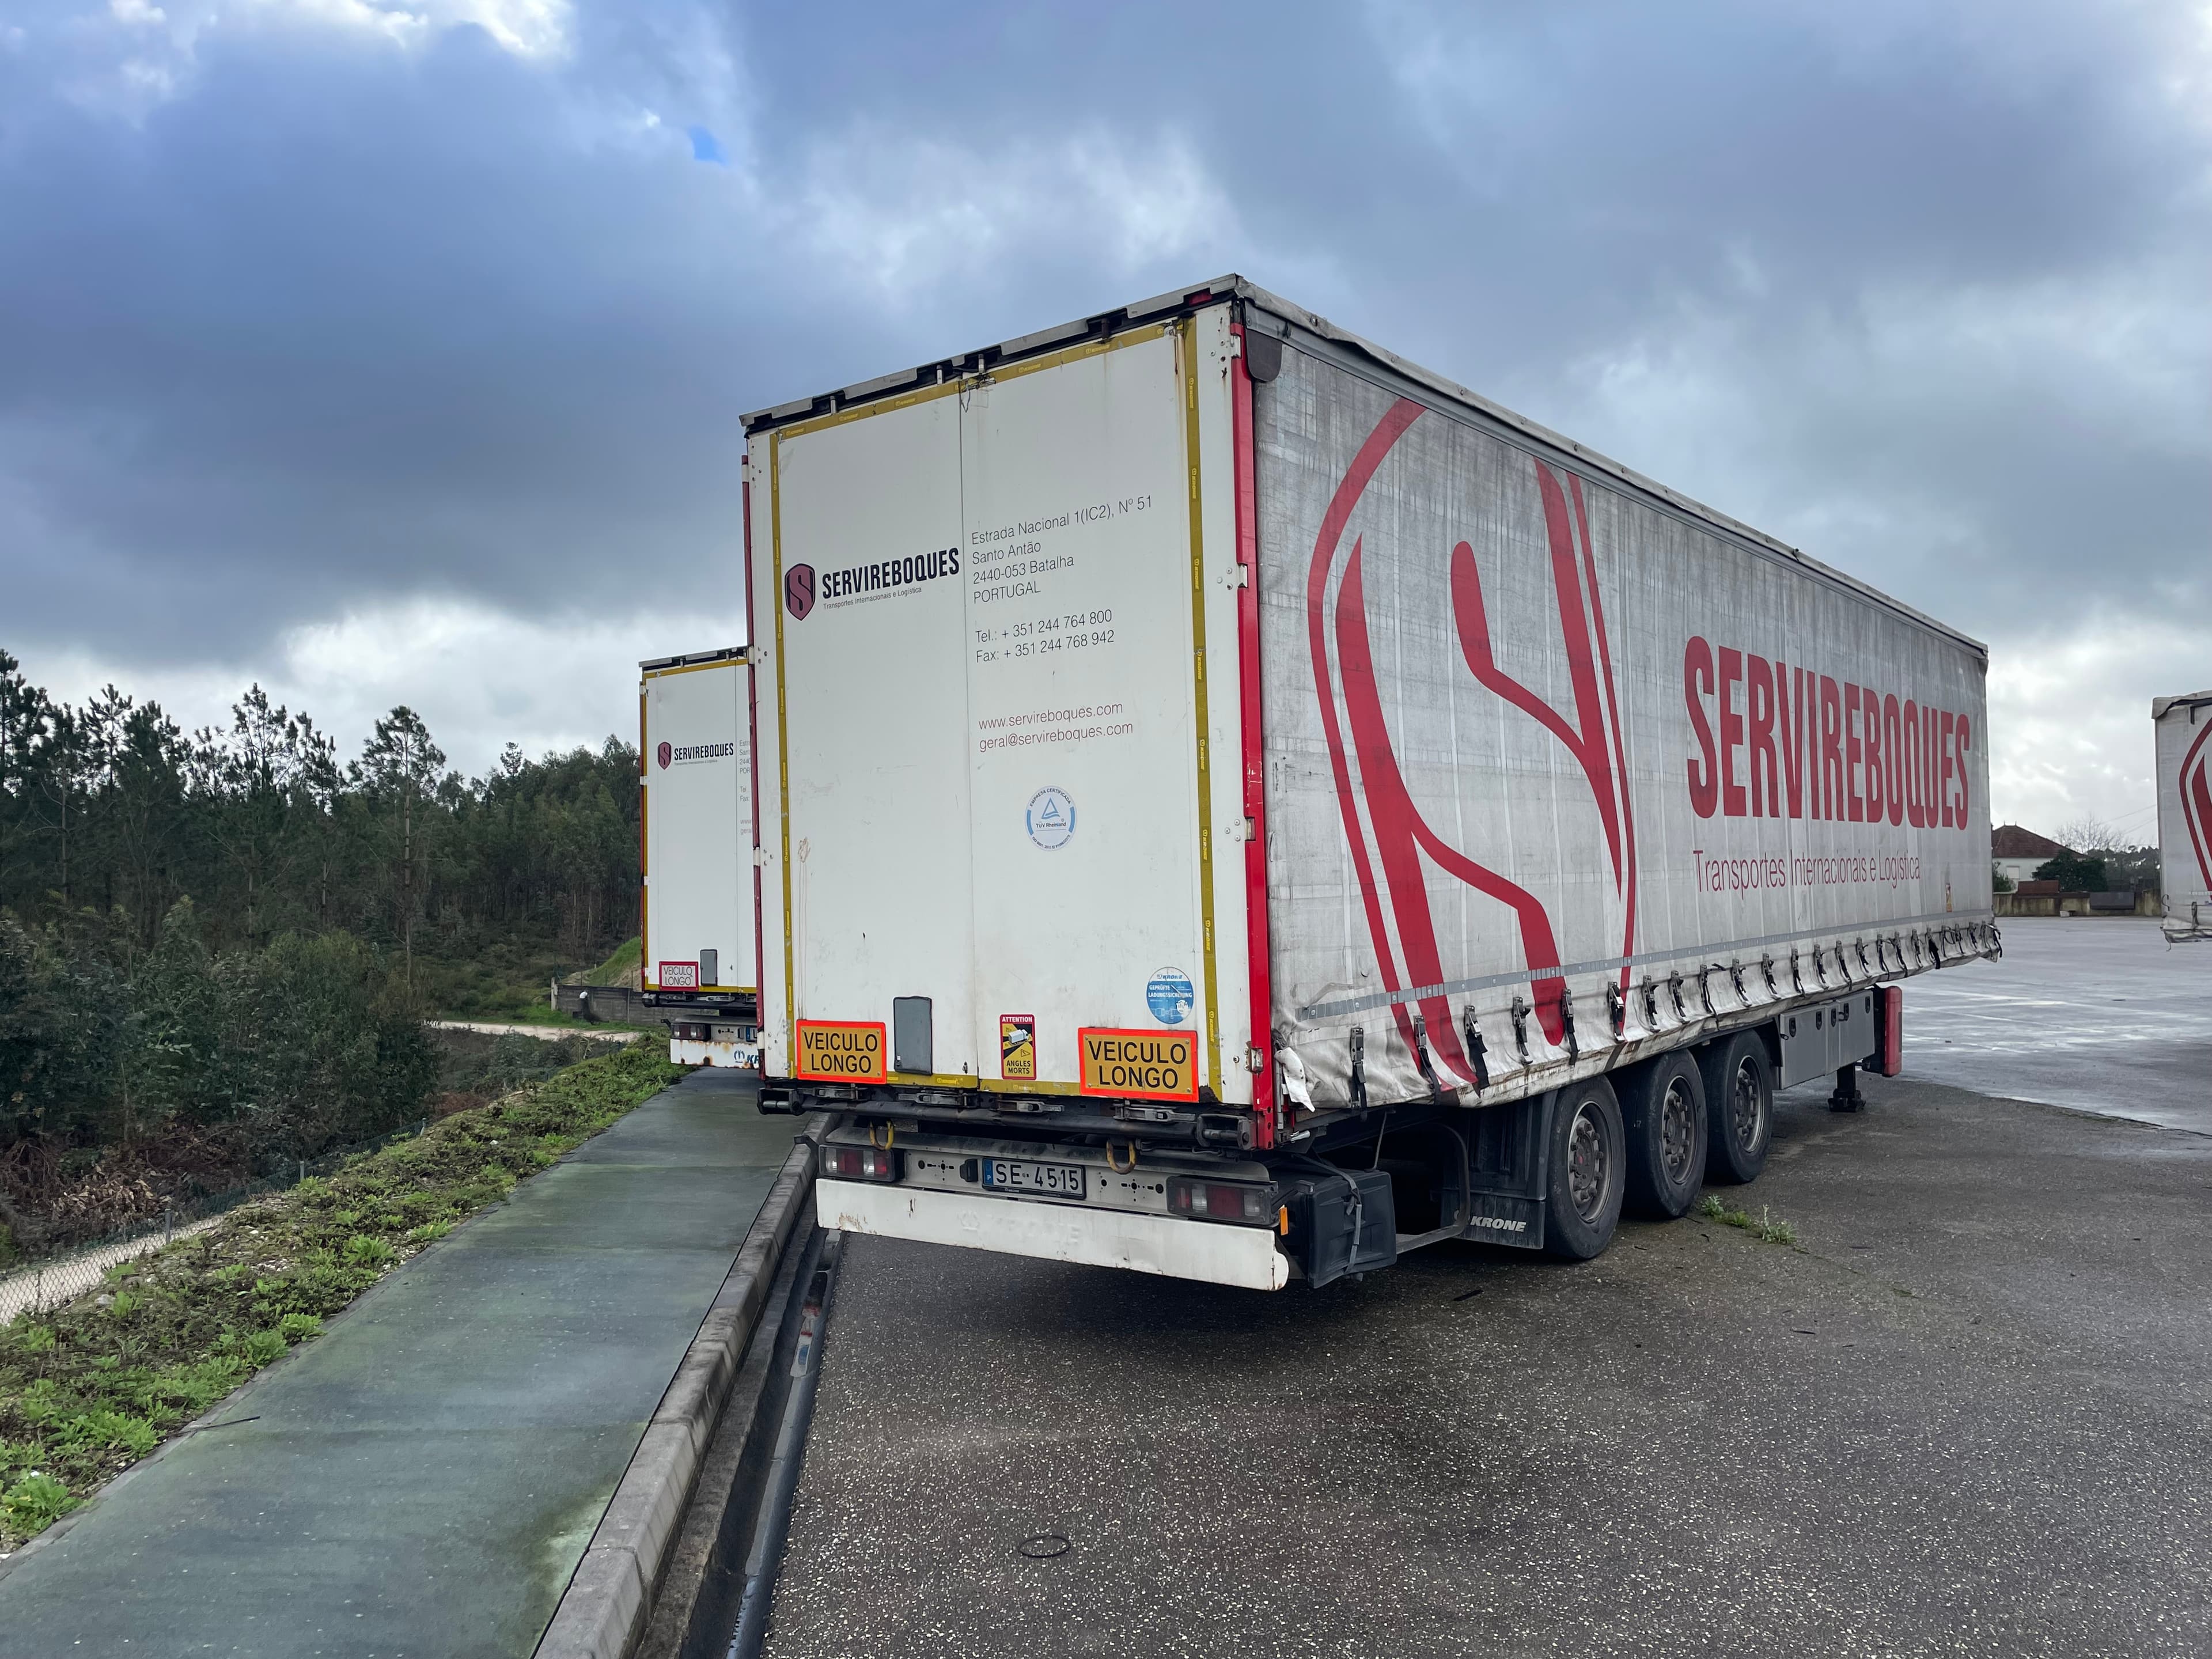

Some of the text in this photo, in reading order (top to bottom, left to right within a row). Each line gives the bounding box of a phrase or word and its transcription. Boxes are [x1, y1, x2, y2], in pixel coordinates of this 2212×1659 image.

[972, 527, 1014, 544] Estrada
[1018, 513, 1069, 535] Nacional
[1138, 495, 1152, 510] 51
[972, 541, 1041, 565] Santo Antão
[822, 547, 960, 599] SERVIREBOQUES
[973, 556, 1074, 584] 2440-053 Batalha
[823, 599, 854, 610] Transportes
[855, 592, 891, 604] Internacionais
[974, 581, 1041, 604] PORTUGAL
[1013, 623, 1032, 637] 351
[1038, 618, 1059, 633] 244
[1064, 613, 1085, 628] 764
[1090, 609, 1112, 624] 800
[976, 650, 999, 662] Fax:
[1015, 642, 1035, 657] 351
[1040, 638, 1062, 653] 244
[1066, 634, 1088, 649] 768
[1092, 630, 1115, 645] 942
[979, 703, 1123, 730] www.servireboques.com
[979, 723, 1133, 752] geral@servireboques.com
[1684, 636, 1969, 830] SERVIREBOQUES
[675, 743, 734, 760] SERVIREBOQUES
[1030, 788, 1071, 807] EMPRESA CERTIFICADA
[1694, 849, 1921, 899] Transportes Internacionais e Logística
[664, 966, 693, 976] VEICULO
[665, 976, 691, 986] LONGO
[804, 1032, 878, 1052] VEICULO
[1088, 1040, 1187, 1064] VEICULO
[811, 1054, 872, 1073] LONGO
[1099, 1065, 1178, 1089] LONGO
[1470, 1215, 1527, 1232] KRONE
